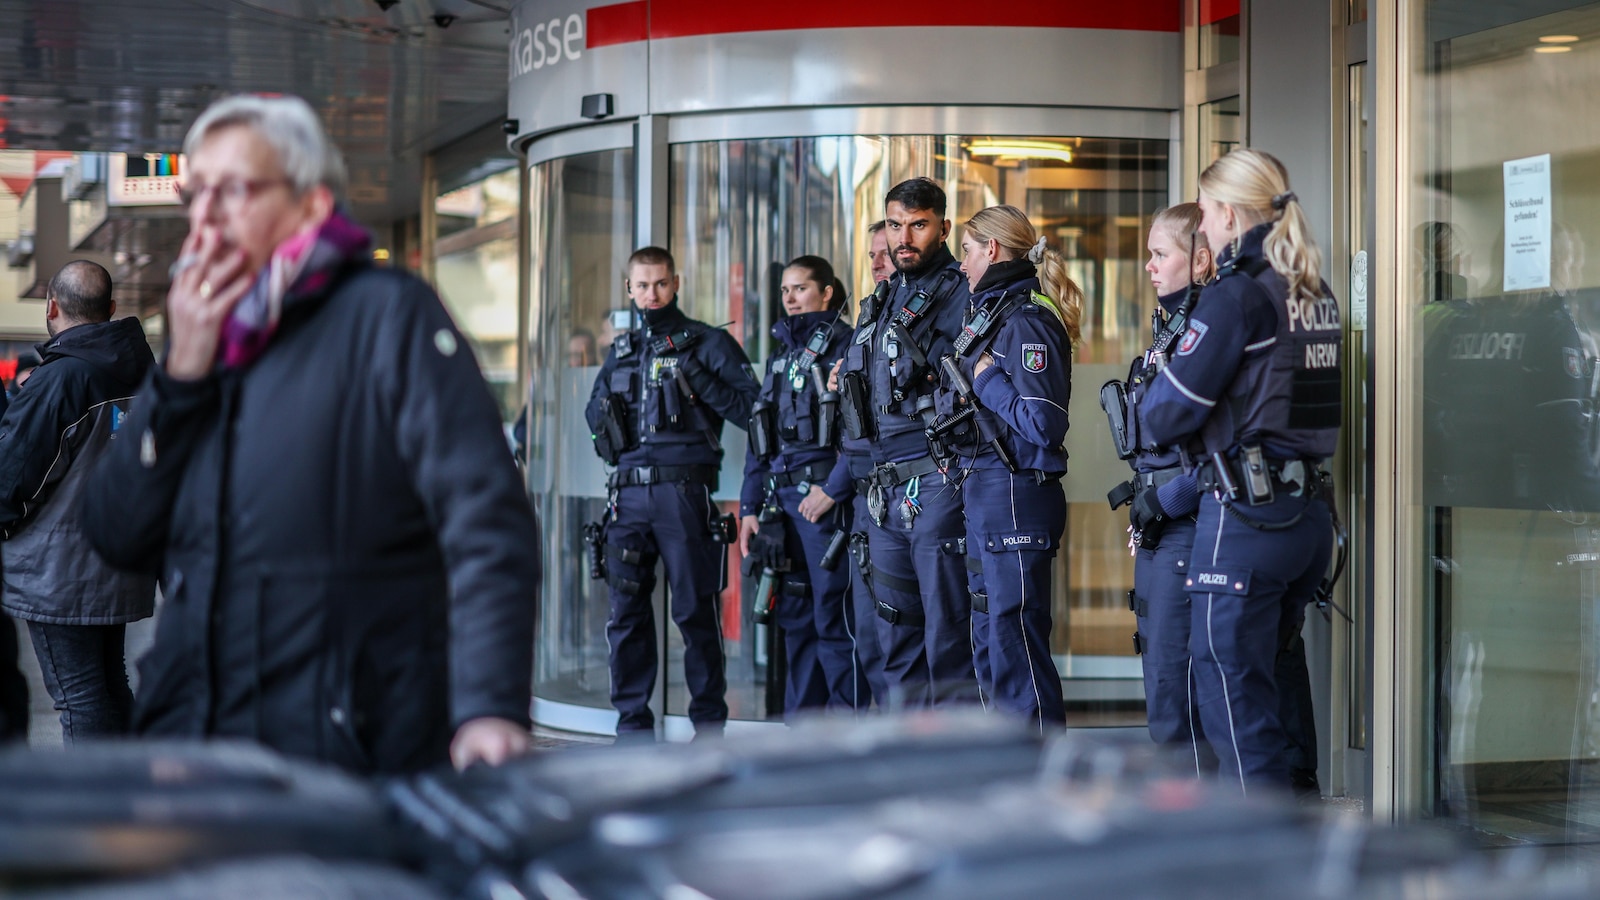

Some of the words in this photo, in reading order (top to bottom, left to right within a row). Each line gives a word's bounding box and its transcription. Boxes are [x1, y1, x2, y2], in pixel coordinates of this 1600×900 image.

[1286, 299, 1341, 332] POLIZE
[1305, 343, 1337, 369] NRW
[1003, 536, 1031, 546] POLIZEI
[1198, 573, 1227, 585] POLIZEI
